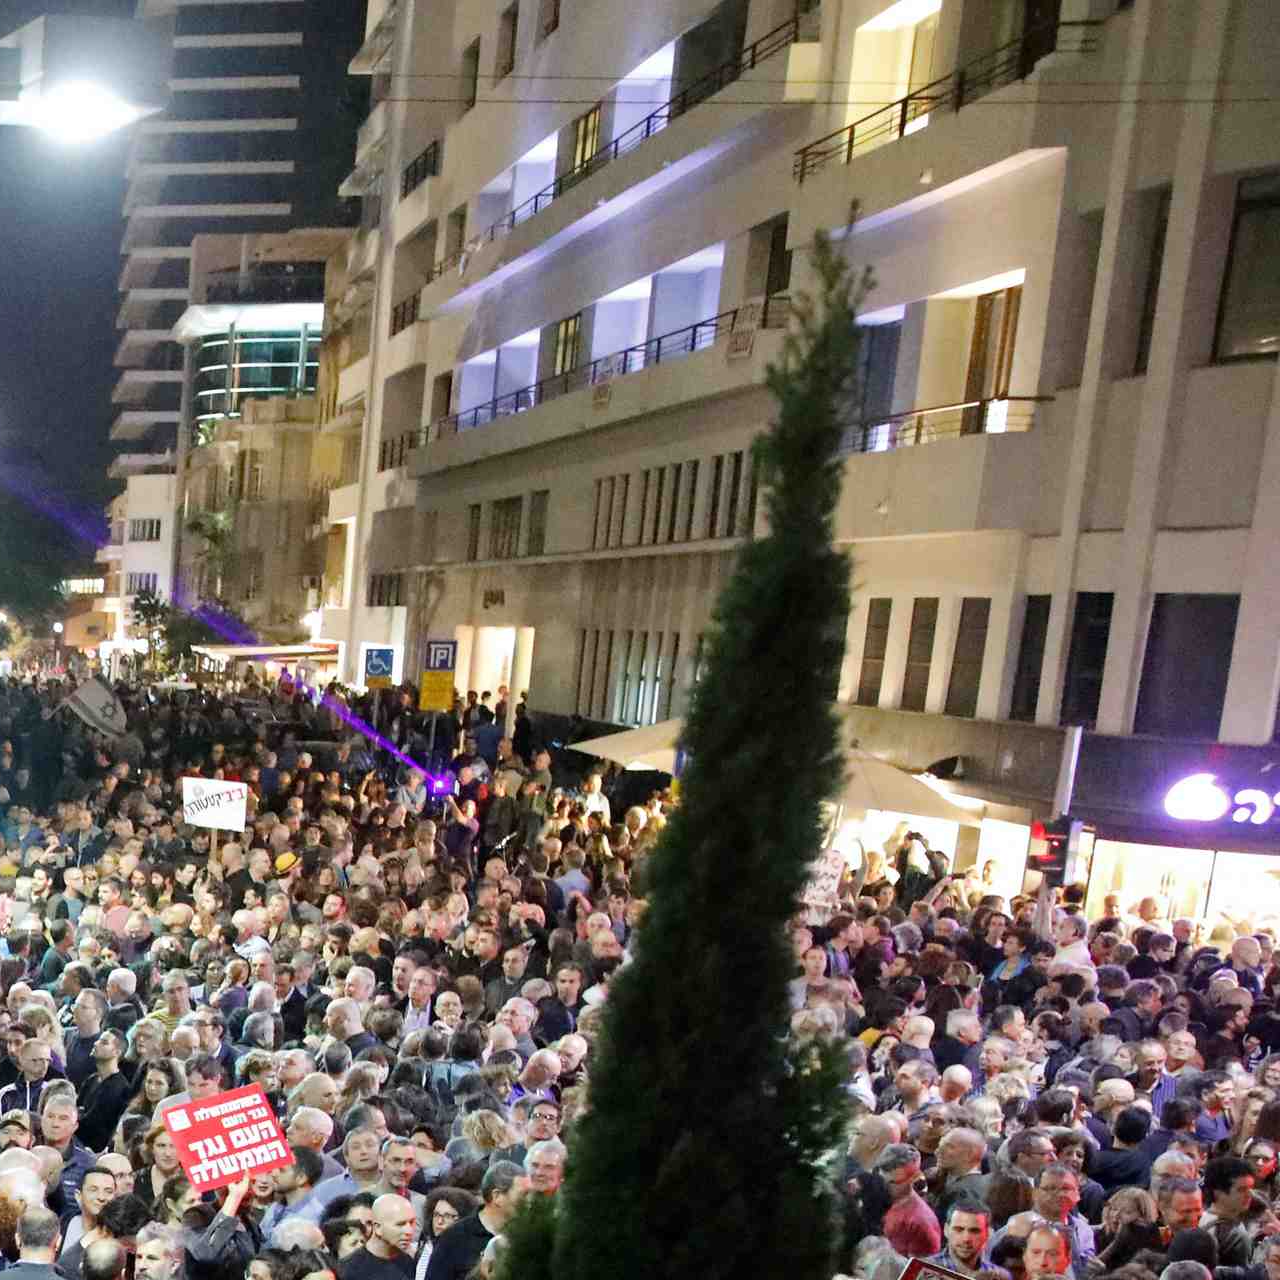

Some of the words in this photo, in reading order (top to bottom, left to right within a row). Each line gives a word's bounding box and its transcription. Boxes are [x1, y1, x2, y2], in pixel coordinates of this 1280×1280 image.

[188, 1135, 228, 1160] נגד
[229, 1120, 278, 1149] העם
[189, 1140, 287, 1184] הממשלה
